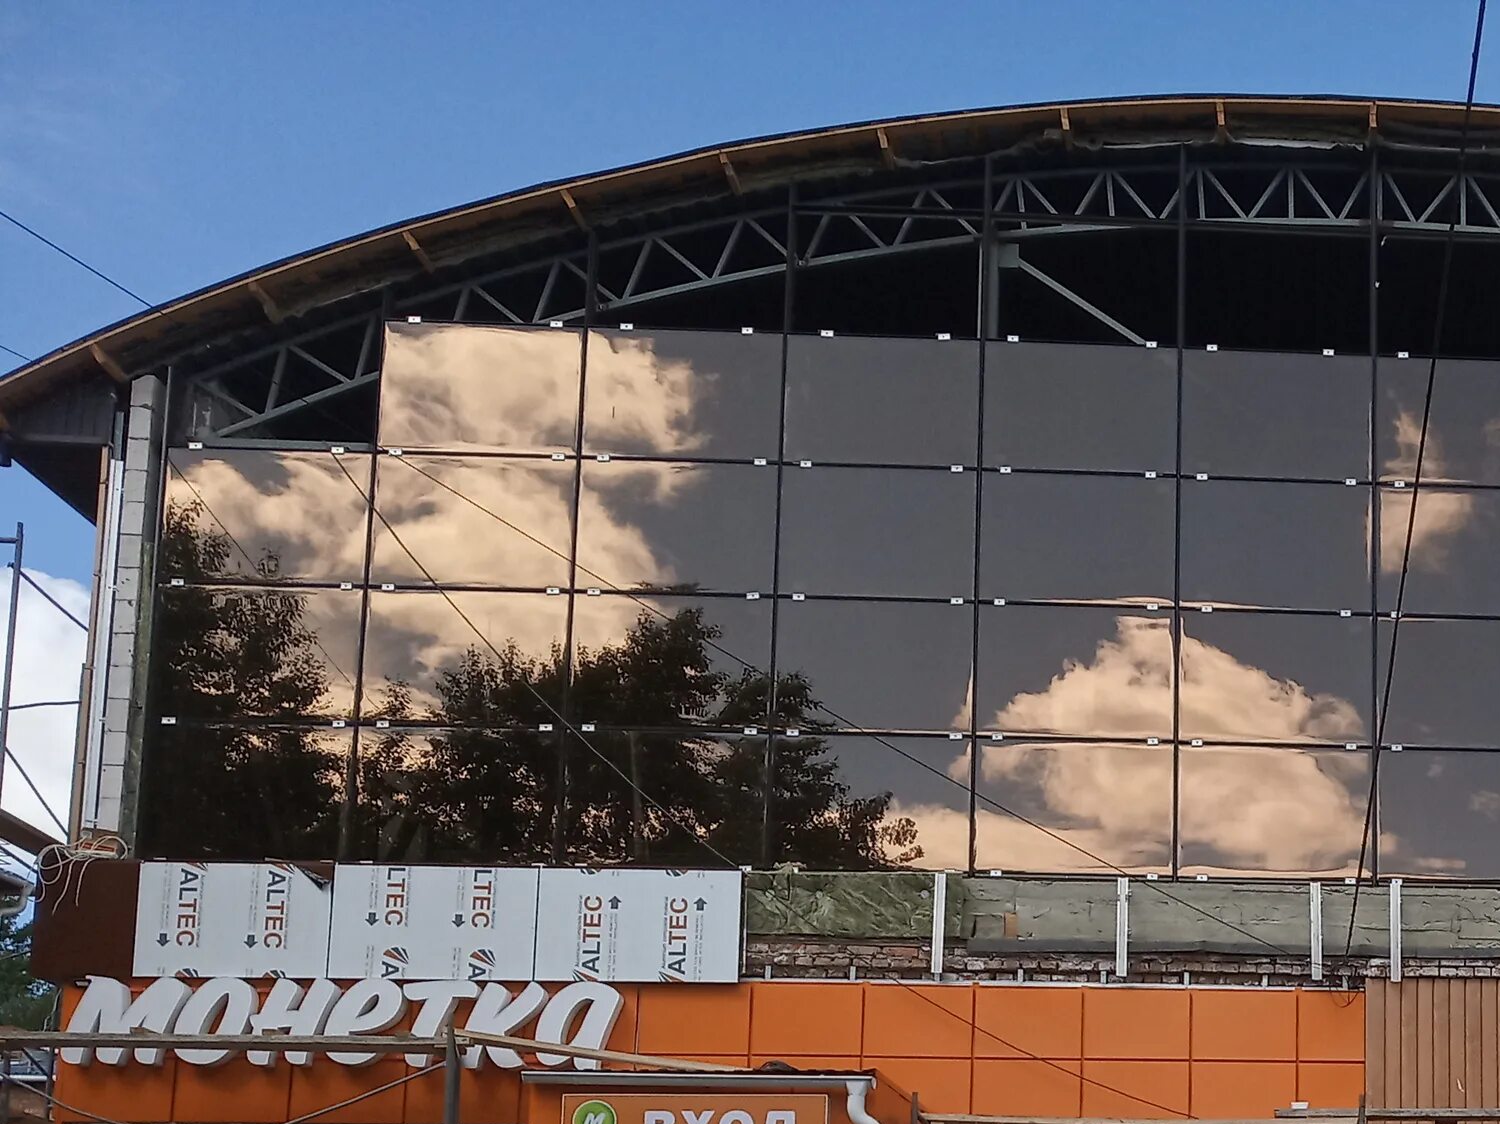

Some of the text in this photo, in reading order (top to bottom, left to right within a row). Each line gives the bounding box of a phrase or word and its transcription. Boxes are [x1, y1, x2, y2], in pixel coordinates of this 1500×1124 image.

[176, 868, 199, 947] ALTEC
[263, 870, 287, 949] ALTEC
[581, 895, 602, 974] ALTEC
[667, 897, 688, 975] ALTEC
